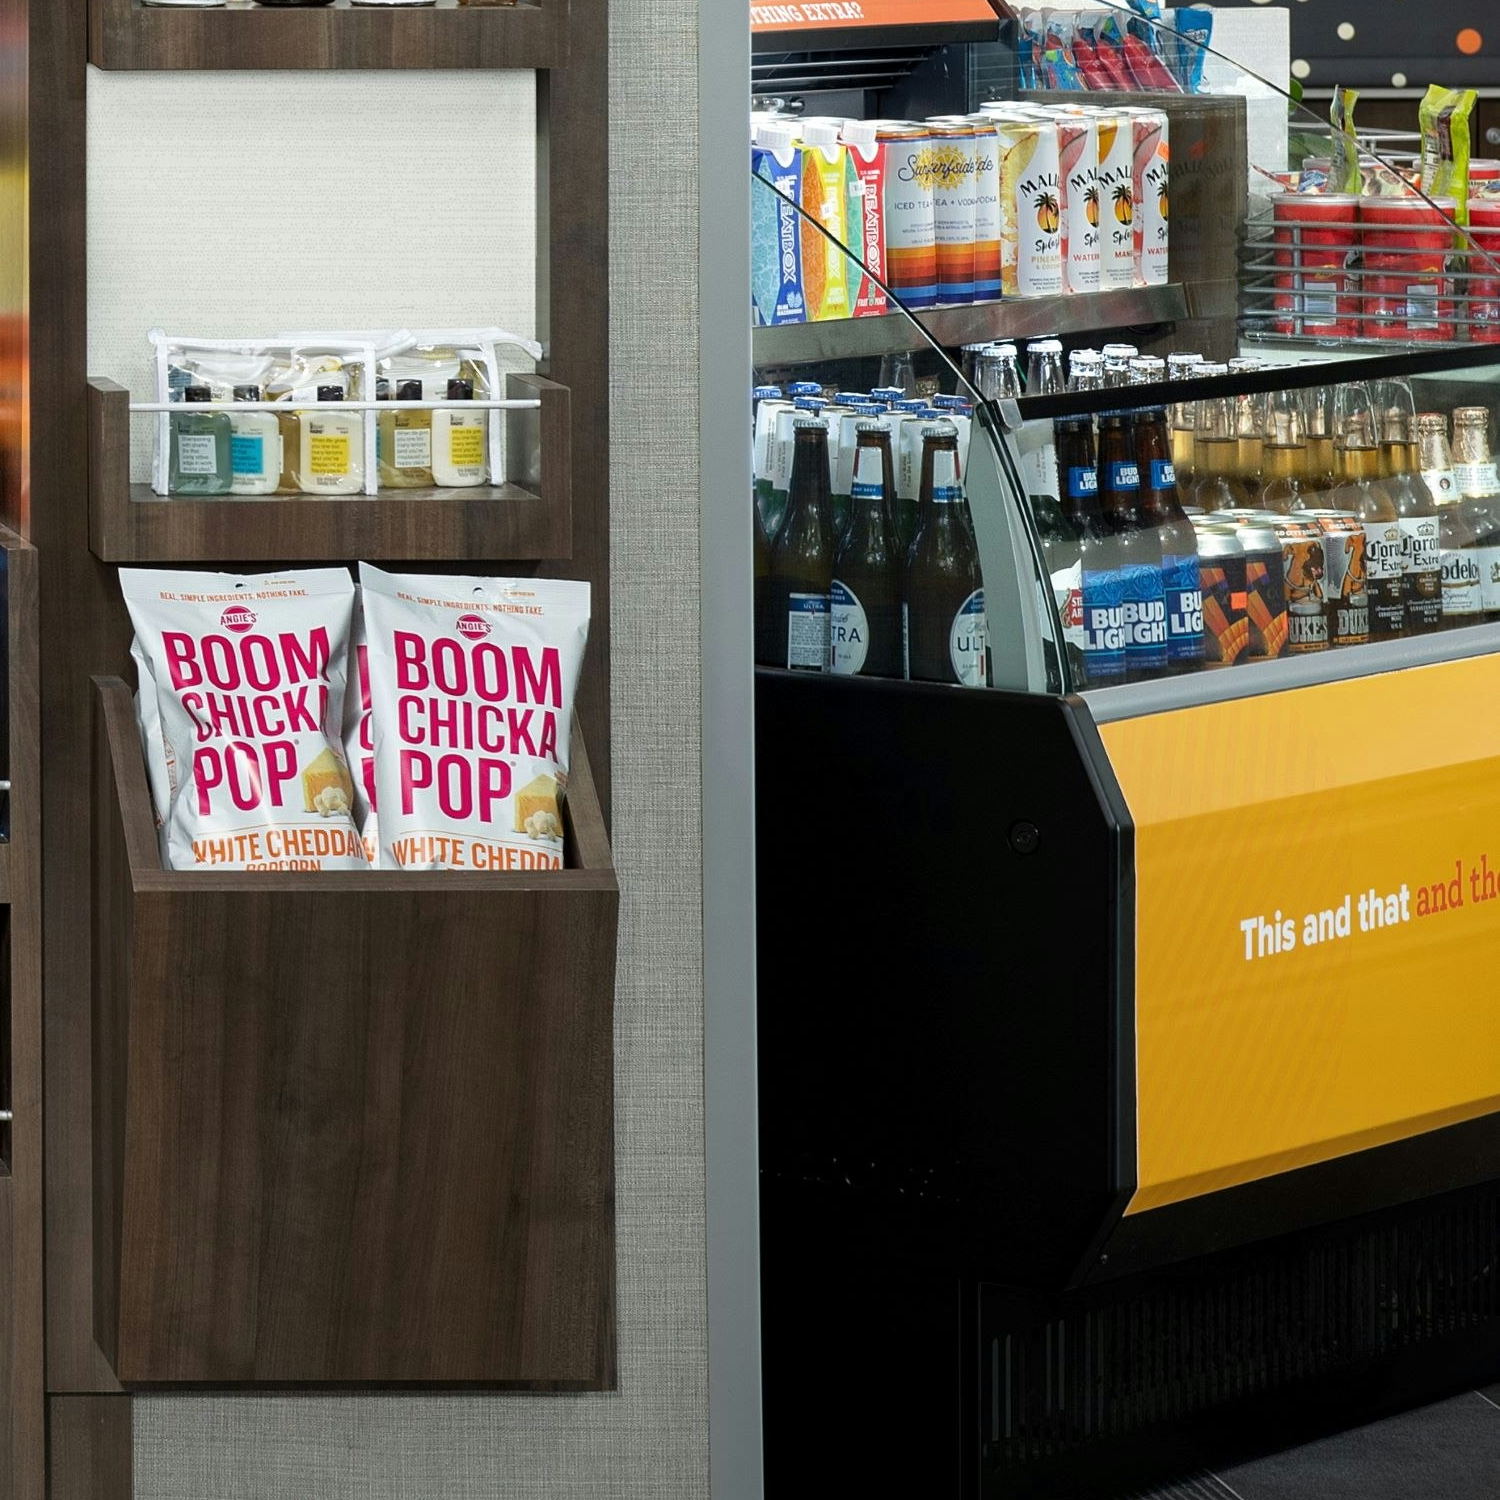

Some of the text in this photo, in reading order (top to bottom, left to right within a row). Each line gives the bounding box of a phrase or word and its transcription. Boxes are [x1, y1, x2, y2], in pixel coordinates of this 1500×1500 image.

[1119, 466, 1138, 476] BUD
[1442, 558, 1479, 580] odelo
[179, 592, 205, 602] SIMPLE
[256, 590, 286, 601] NOTHING
[1123, 601, 1165, 623] BUD
[160, 625, 332, 693] BOOM
[393, 629, 562, 710] BOOM
[397, 693, 559, 765] CHICKA
[192, 739, 298, 817] POP
[400, 749, 512, 824] POP
[191, 830, 262, 865] WHITE
[391, 835, 563, 871] WHITE CHEDDA
[1240, 909, 1296, 961] This
[1303, 894, 1351, 946] and
[1358, 883, 1410, 933] that
[1416, 859, 1464, 917] and
